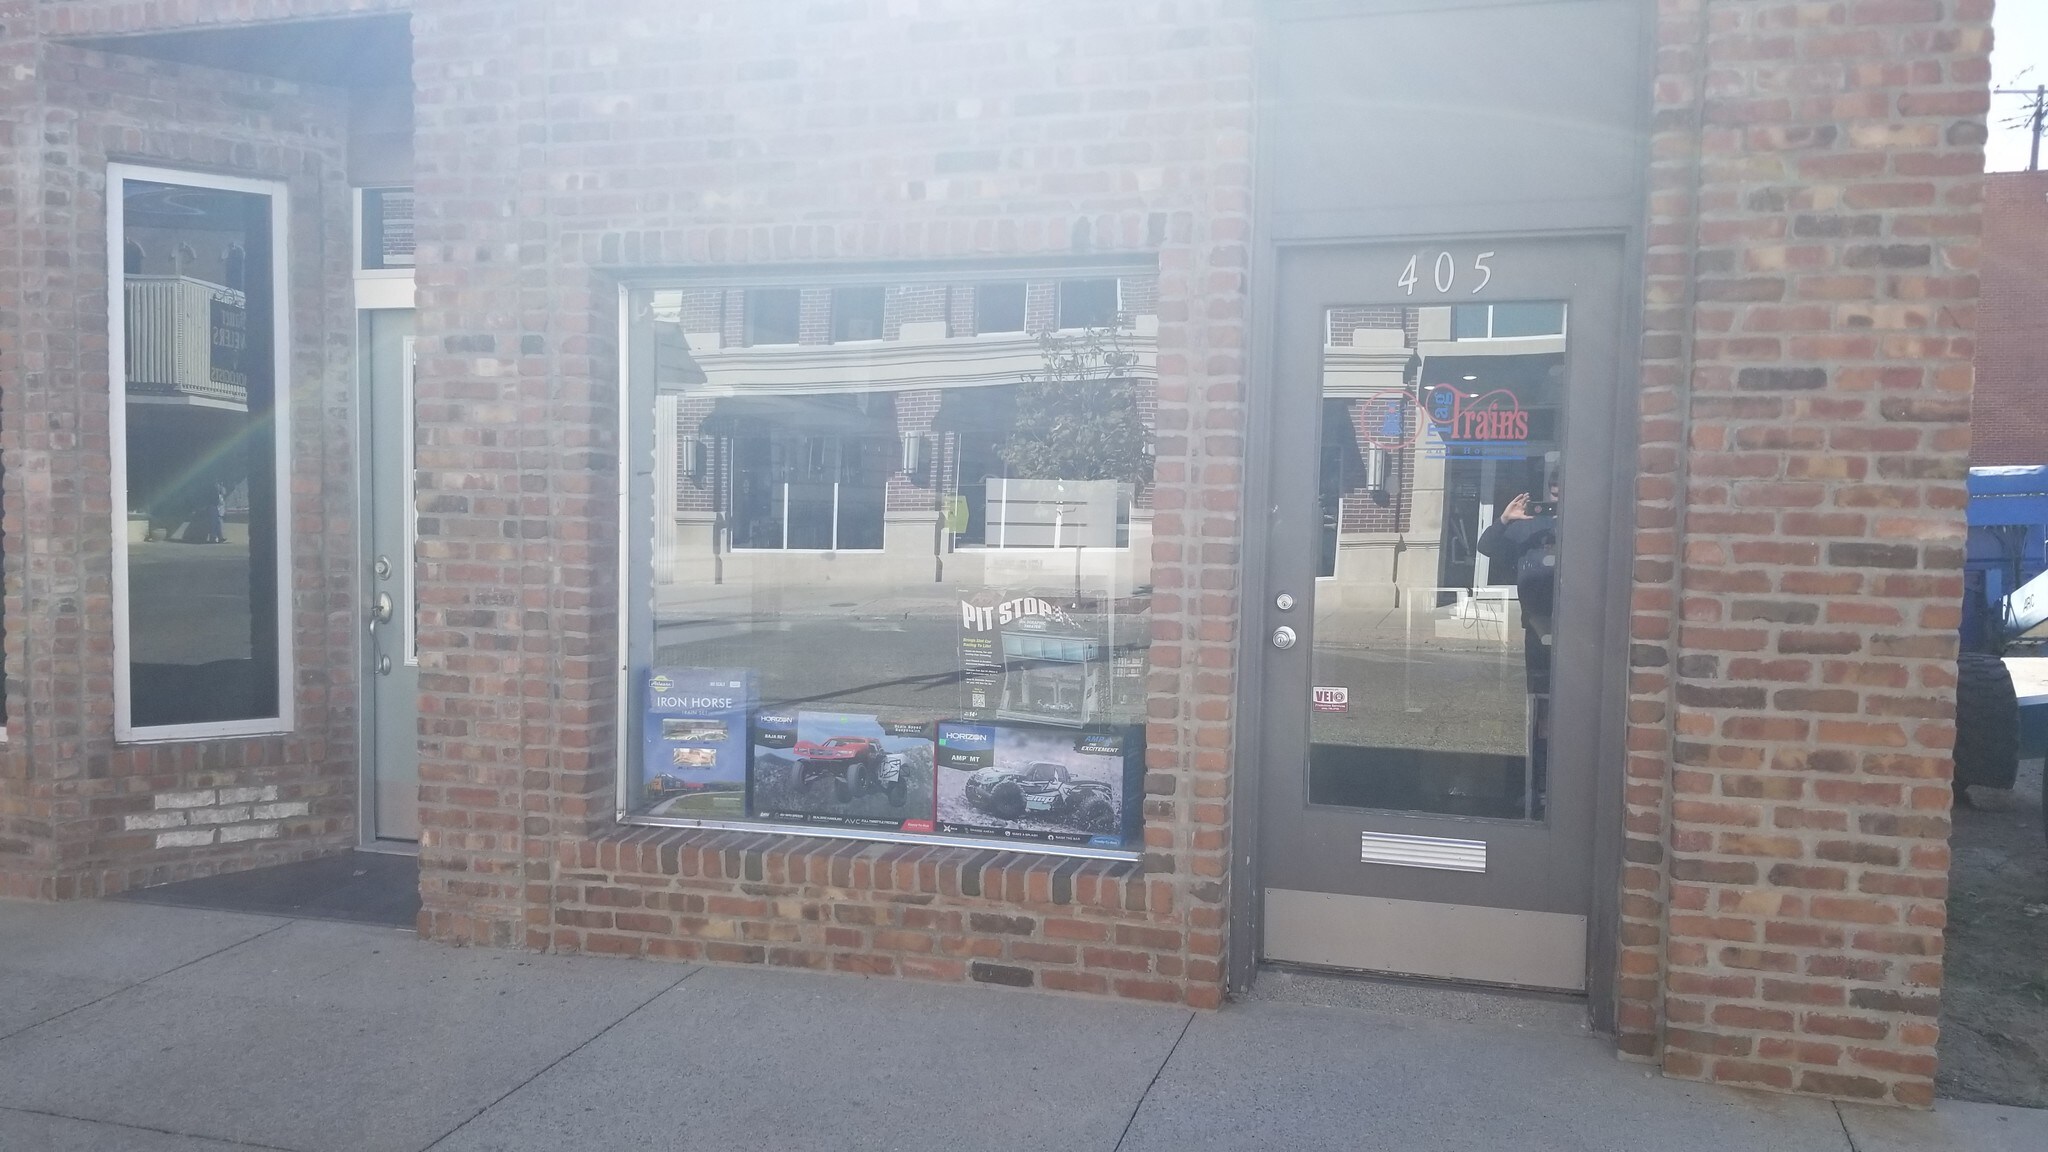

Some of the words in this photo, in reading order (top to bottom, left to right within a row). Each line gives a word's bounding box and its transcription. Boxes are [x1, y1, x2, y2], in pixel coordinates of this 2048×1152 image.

[1398, 251, 1495, 296] 405
[1427, 391, 1453, 437] Tag
[1450, 386, 1529, 440] Trains
[961, 600, 994, 632] PIT
[998, 597, 1052, 625] STOP
[657, 696, 687, 707] IRON
[691, 697, 733, 709] HORSE
[760, 715, 793, 724] HORIZON
[946, 732, 987, 741] HORIZON
[1085, 735, 1105, 743] AMP
[1080, 745, 1119, 753] EXCITEMENT
